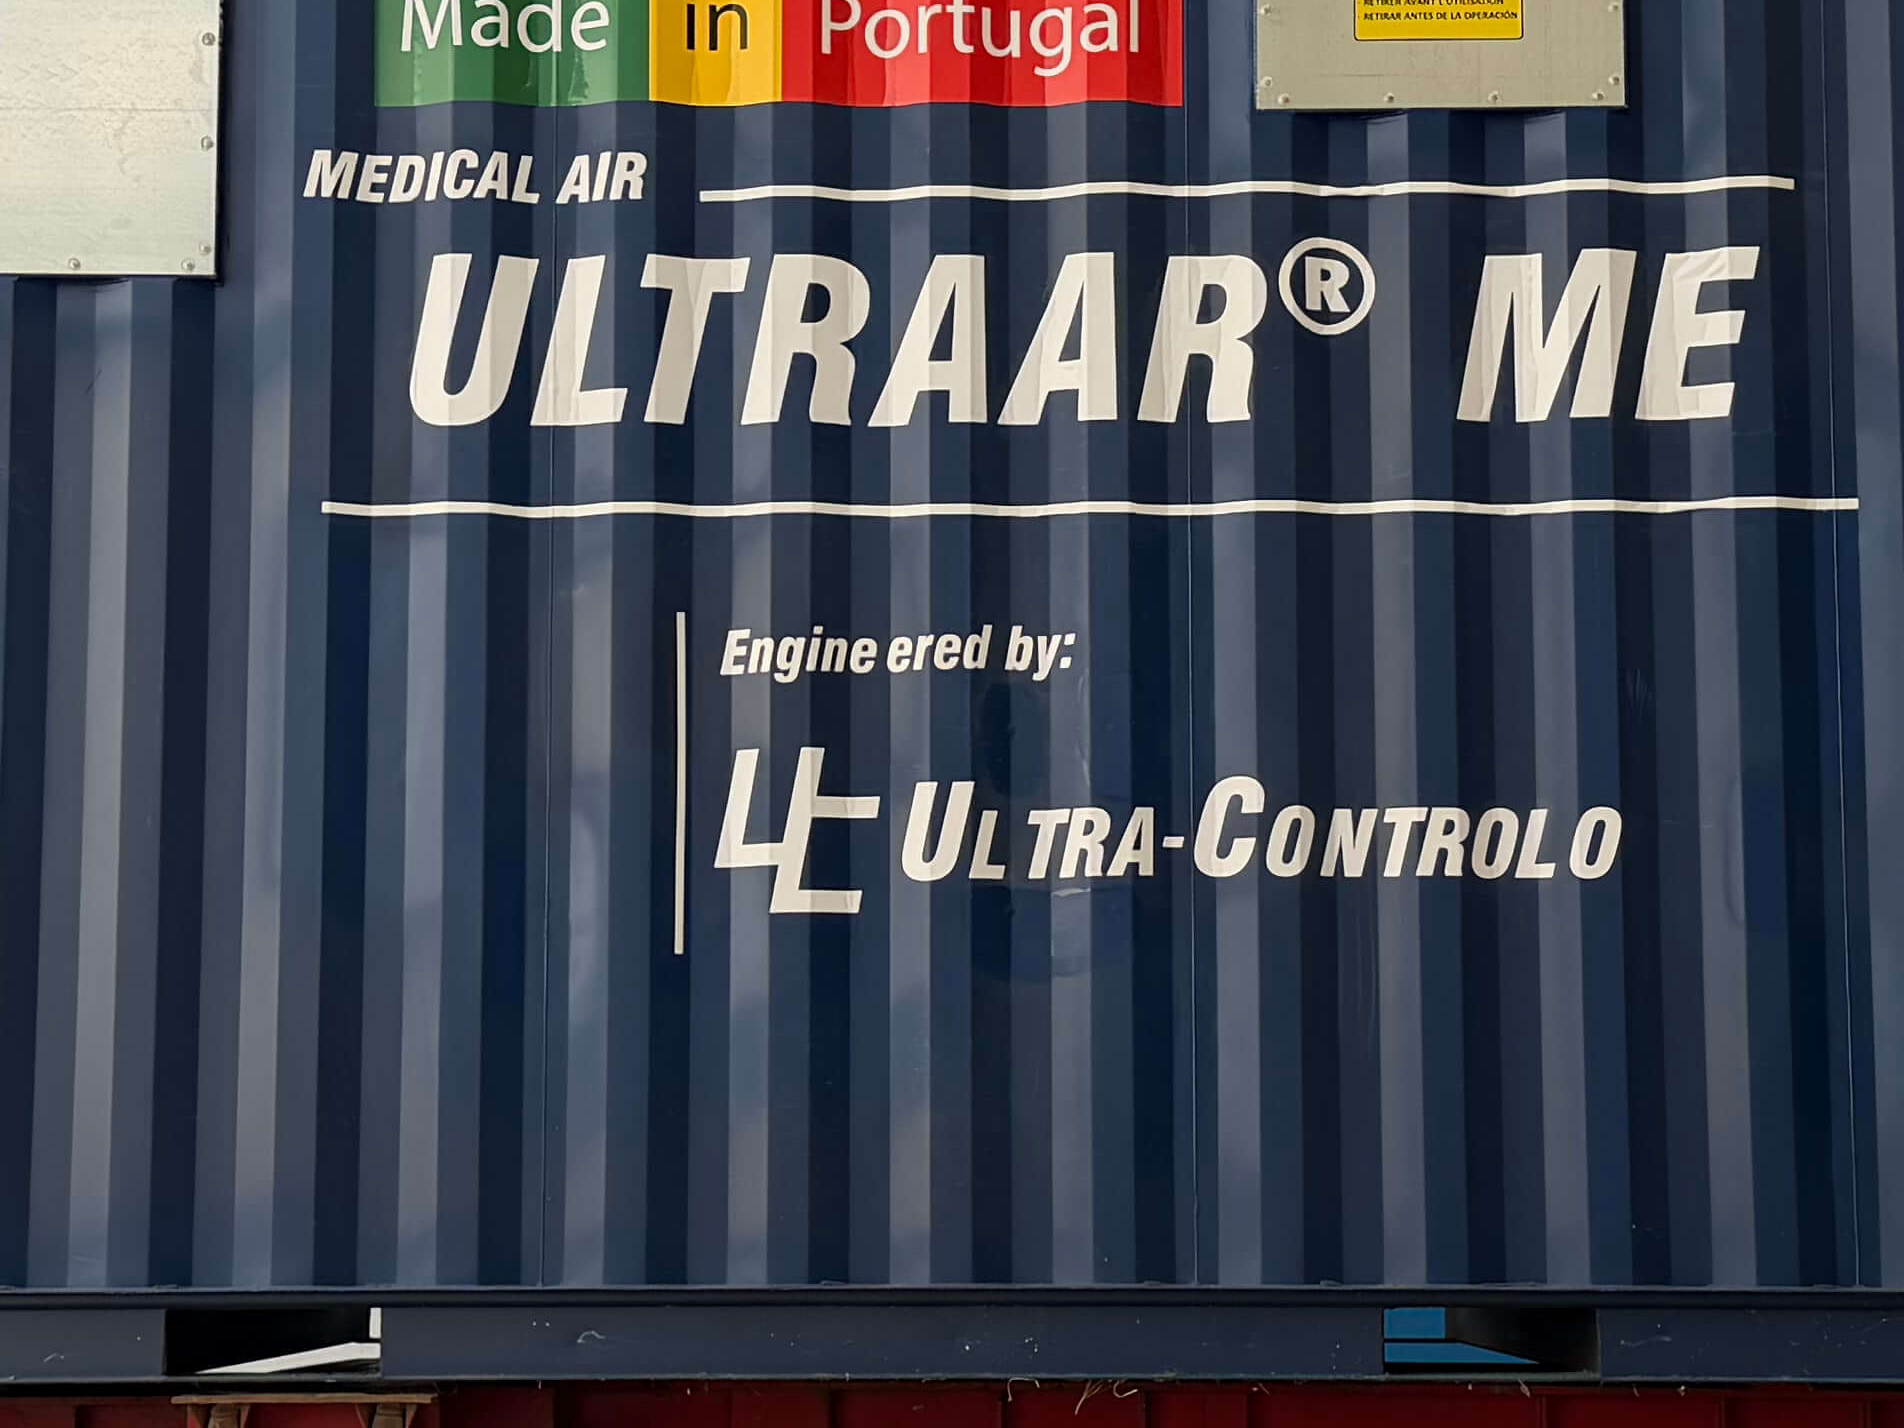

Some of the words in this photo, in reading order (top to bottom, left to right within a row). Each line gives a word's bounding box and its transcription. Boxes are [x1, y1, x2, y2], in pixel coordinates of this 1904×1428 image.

[1363, 12, 1401, 20] RETIRAR
[1404, 12, 1433, 20] ANTES
[1436, 11, 1448, 20] DE
[1450, 11, 1462, 20] LA
[302, 148, 540, 204] MEDICAL
[555, 149, 648, 204] AIR
[1457, 246, 1760, 422] ME
[1004, 625, 1077, 682] by:
